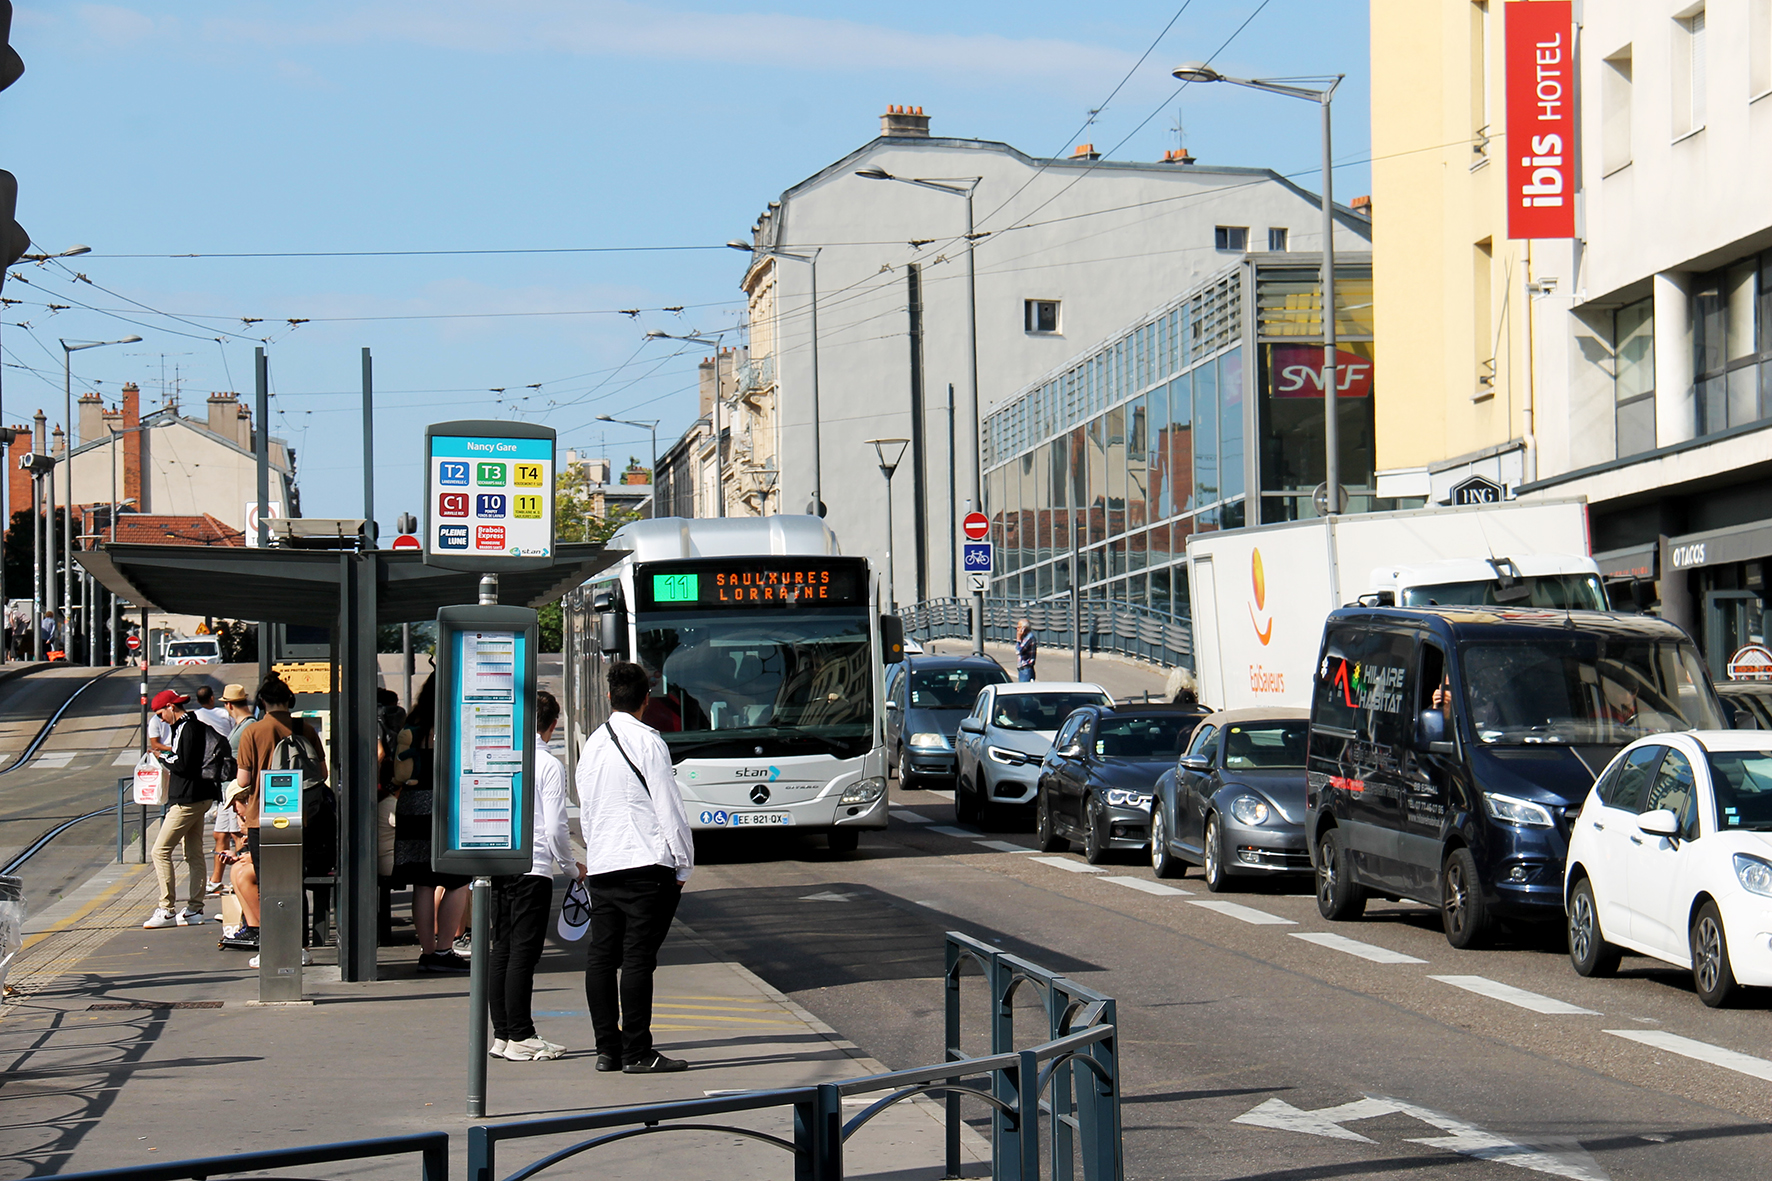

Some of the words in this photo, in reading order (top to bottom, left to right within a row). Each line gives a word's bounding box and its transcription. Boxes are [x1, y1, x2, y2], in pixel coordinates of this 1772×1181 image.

[1536, 32, 1562, 120] HOTEL
[1521, 134, 1563, 208] ibis
[467, 442, 494, 453] Nancy
[496, 442, 517, 452] Gare
[444, 464, 465, 479] T2
[481, 465, 501, 479] T3
[518, 466, 538, 480] T4
[443, 495, 463, 510] C1
[481, 495, 501, 510] 10
[519, 497, 536, 510] 11
[440, 528, 467, 537] PLEINE
[448, 537, 467, 546] LUNE
[716, 571, 830, 586] SAULXURES
[664, 576, 689, 599] 11
[719, 586, 828, 601] LORRAINE
[1249, 664, 1285, 698] EpiSaveurs
[1363, 665, 1405, 688] HILAIRE
[1358, 689, 1403, 714] HABITAT
[735, 767, 768, 778] stan
